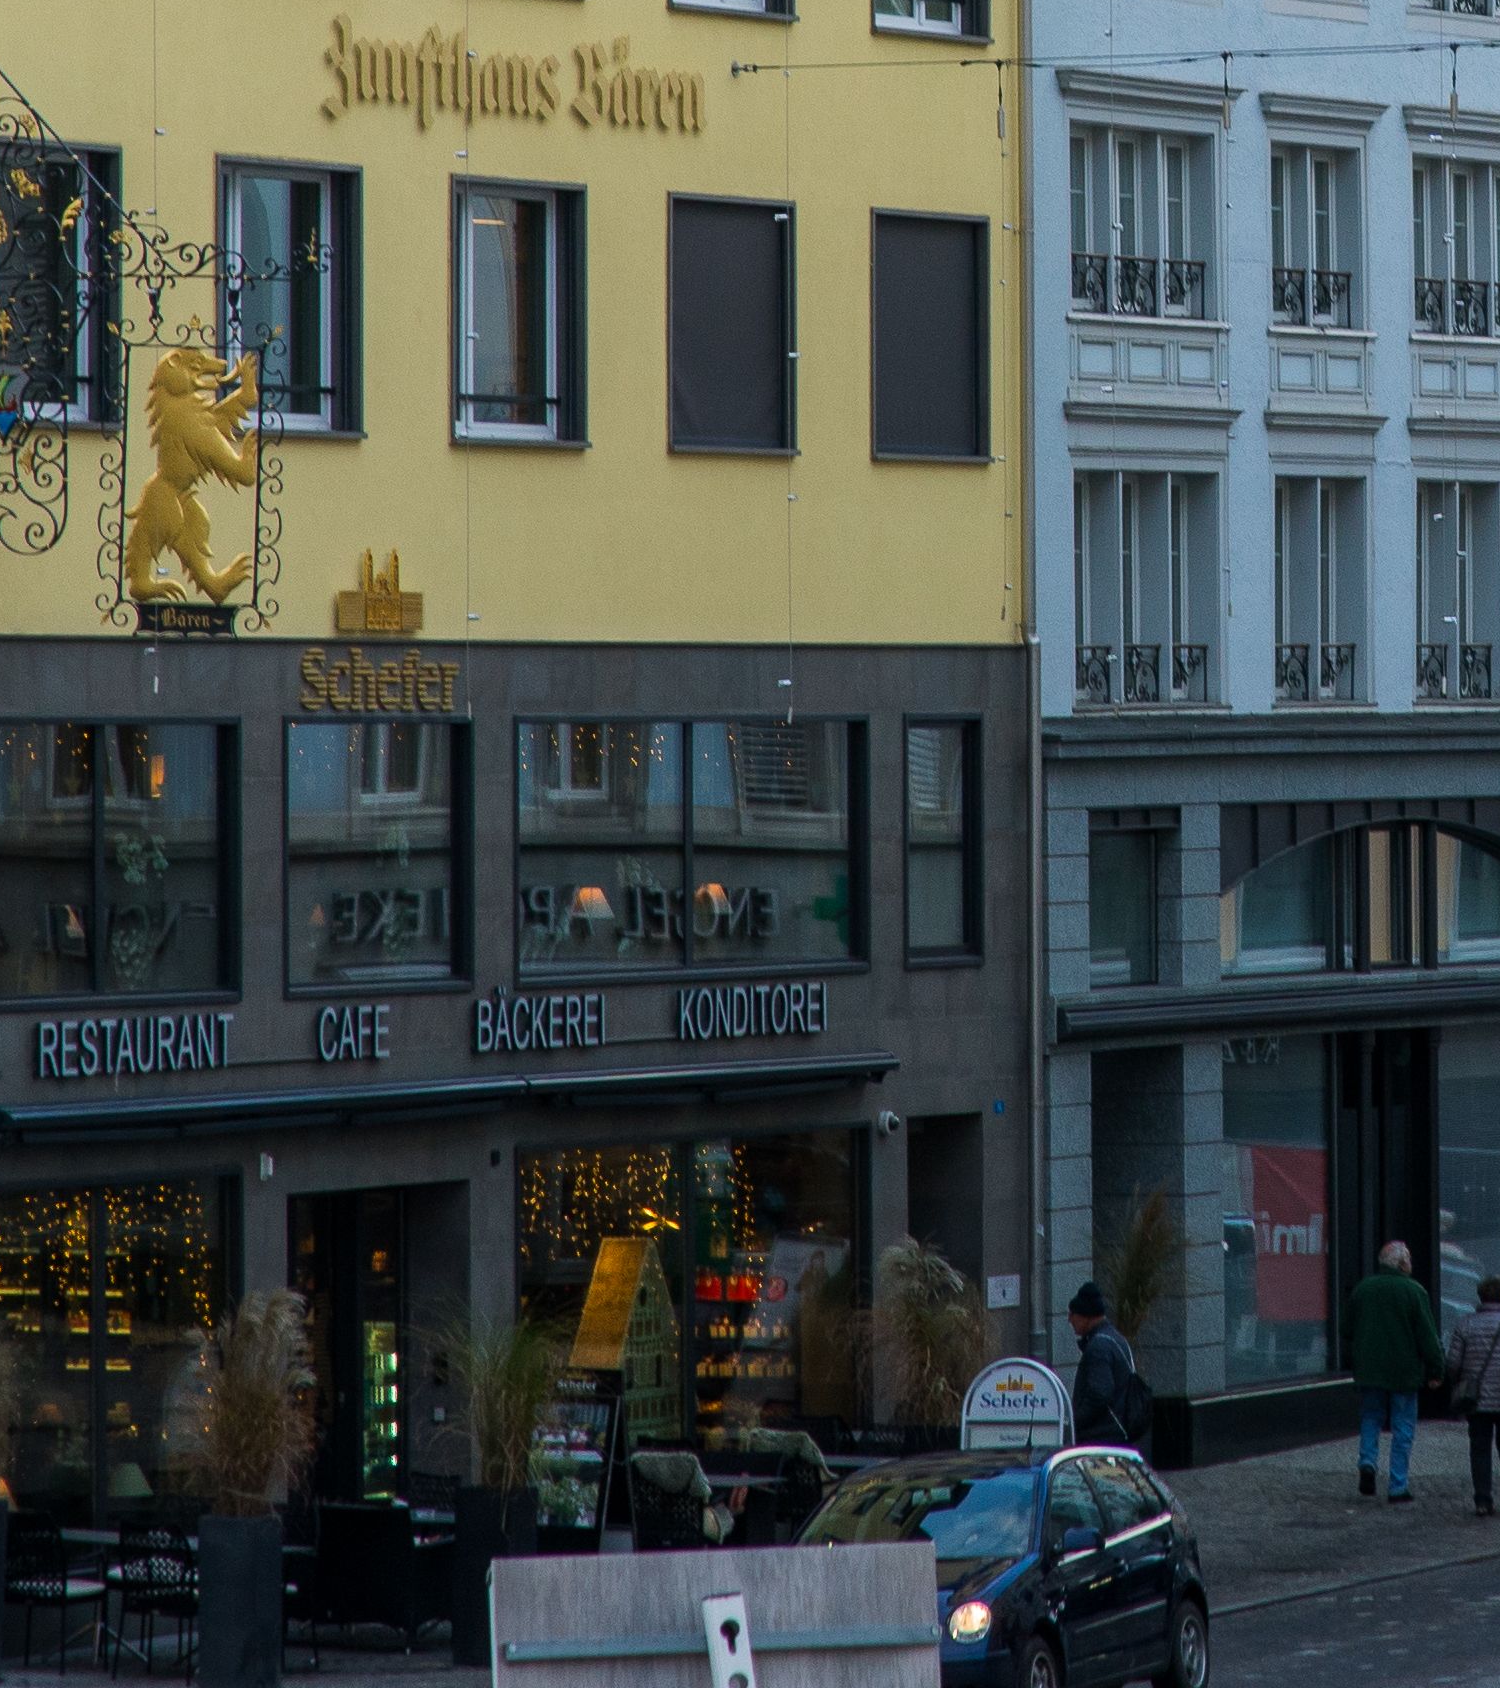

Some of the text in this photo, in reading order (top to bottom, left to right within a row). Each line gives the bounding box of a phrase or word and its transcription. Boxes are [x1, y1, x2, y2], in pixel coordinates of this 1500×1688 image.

[571, 36, 706, 132] Bären
[160, 607, 212, 629] Bären
[300, 647, 461, 712] Schefer
[38, 982, 829, 1078] RESTAURANT CAFE BÄCKEREI KONDITOREI
[979, 1391, 1049, 1410] Schefer
